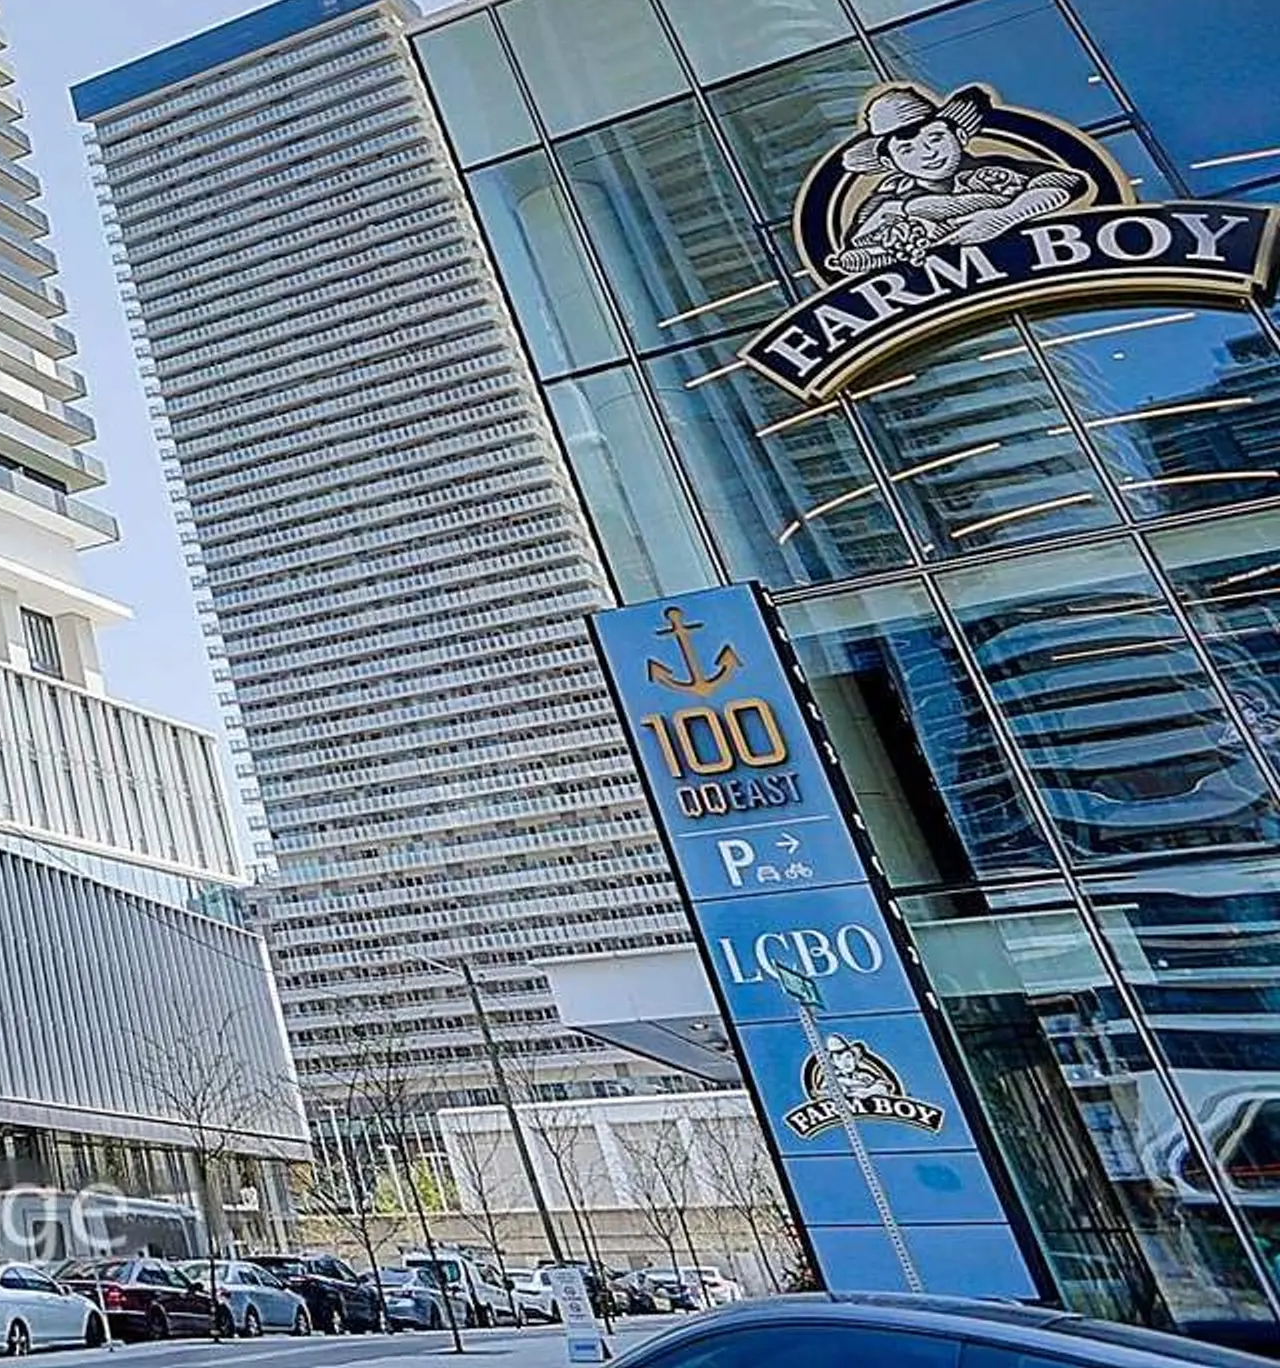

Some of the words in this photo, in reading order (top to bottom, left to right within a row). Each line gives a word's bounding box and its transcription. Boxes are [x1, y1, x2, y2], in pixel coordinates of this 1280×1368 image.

[764, 246, 1007, 378] FARM
[1022, 212, 1249, 272] BOY
[640, 697, 787, 778] 100
[717, 839, 755, 888] P
[719, 923, 884, 984] LCBO
[790, 1096, 867, 1131] FARM
[872, 1096, 939, 1125] BOY
